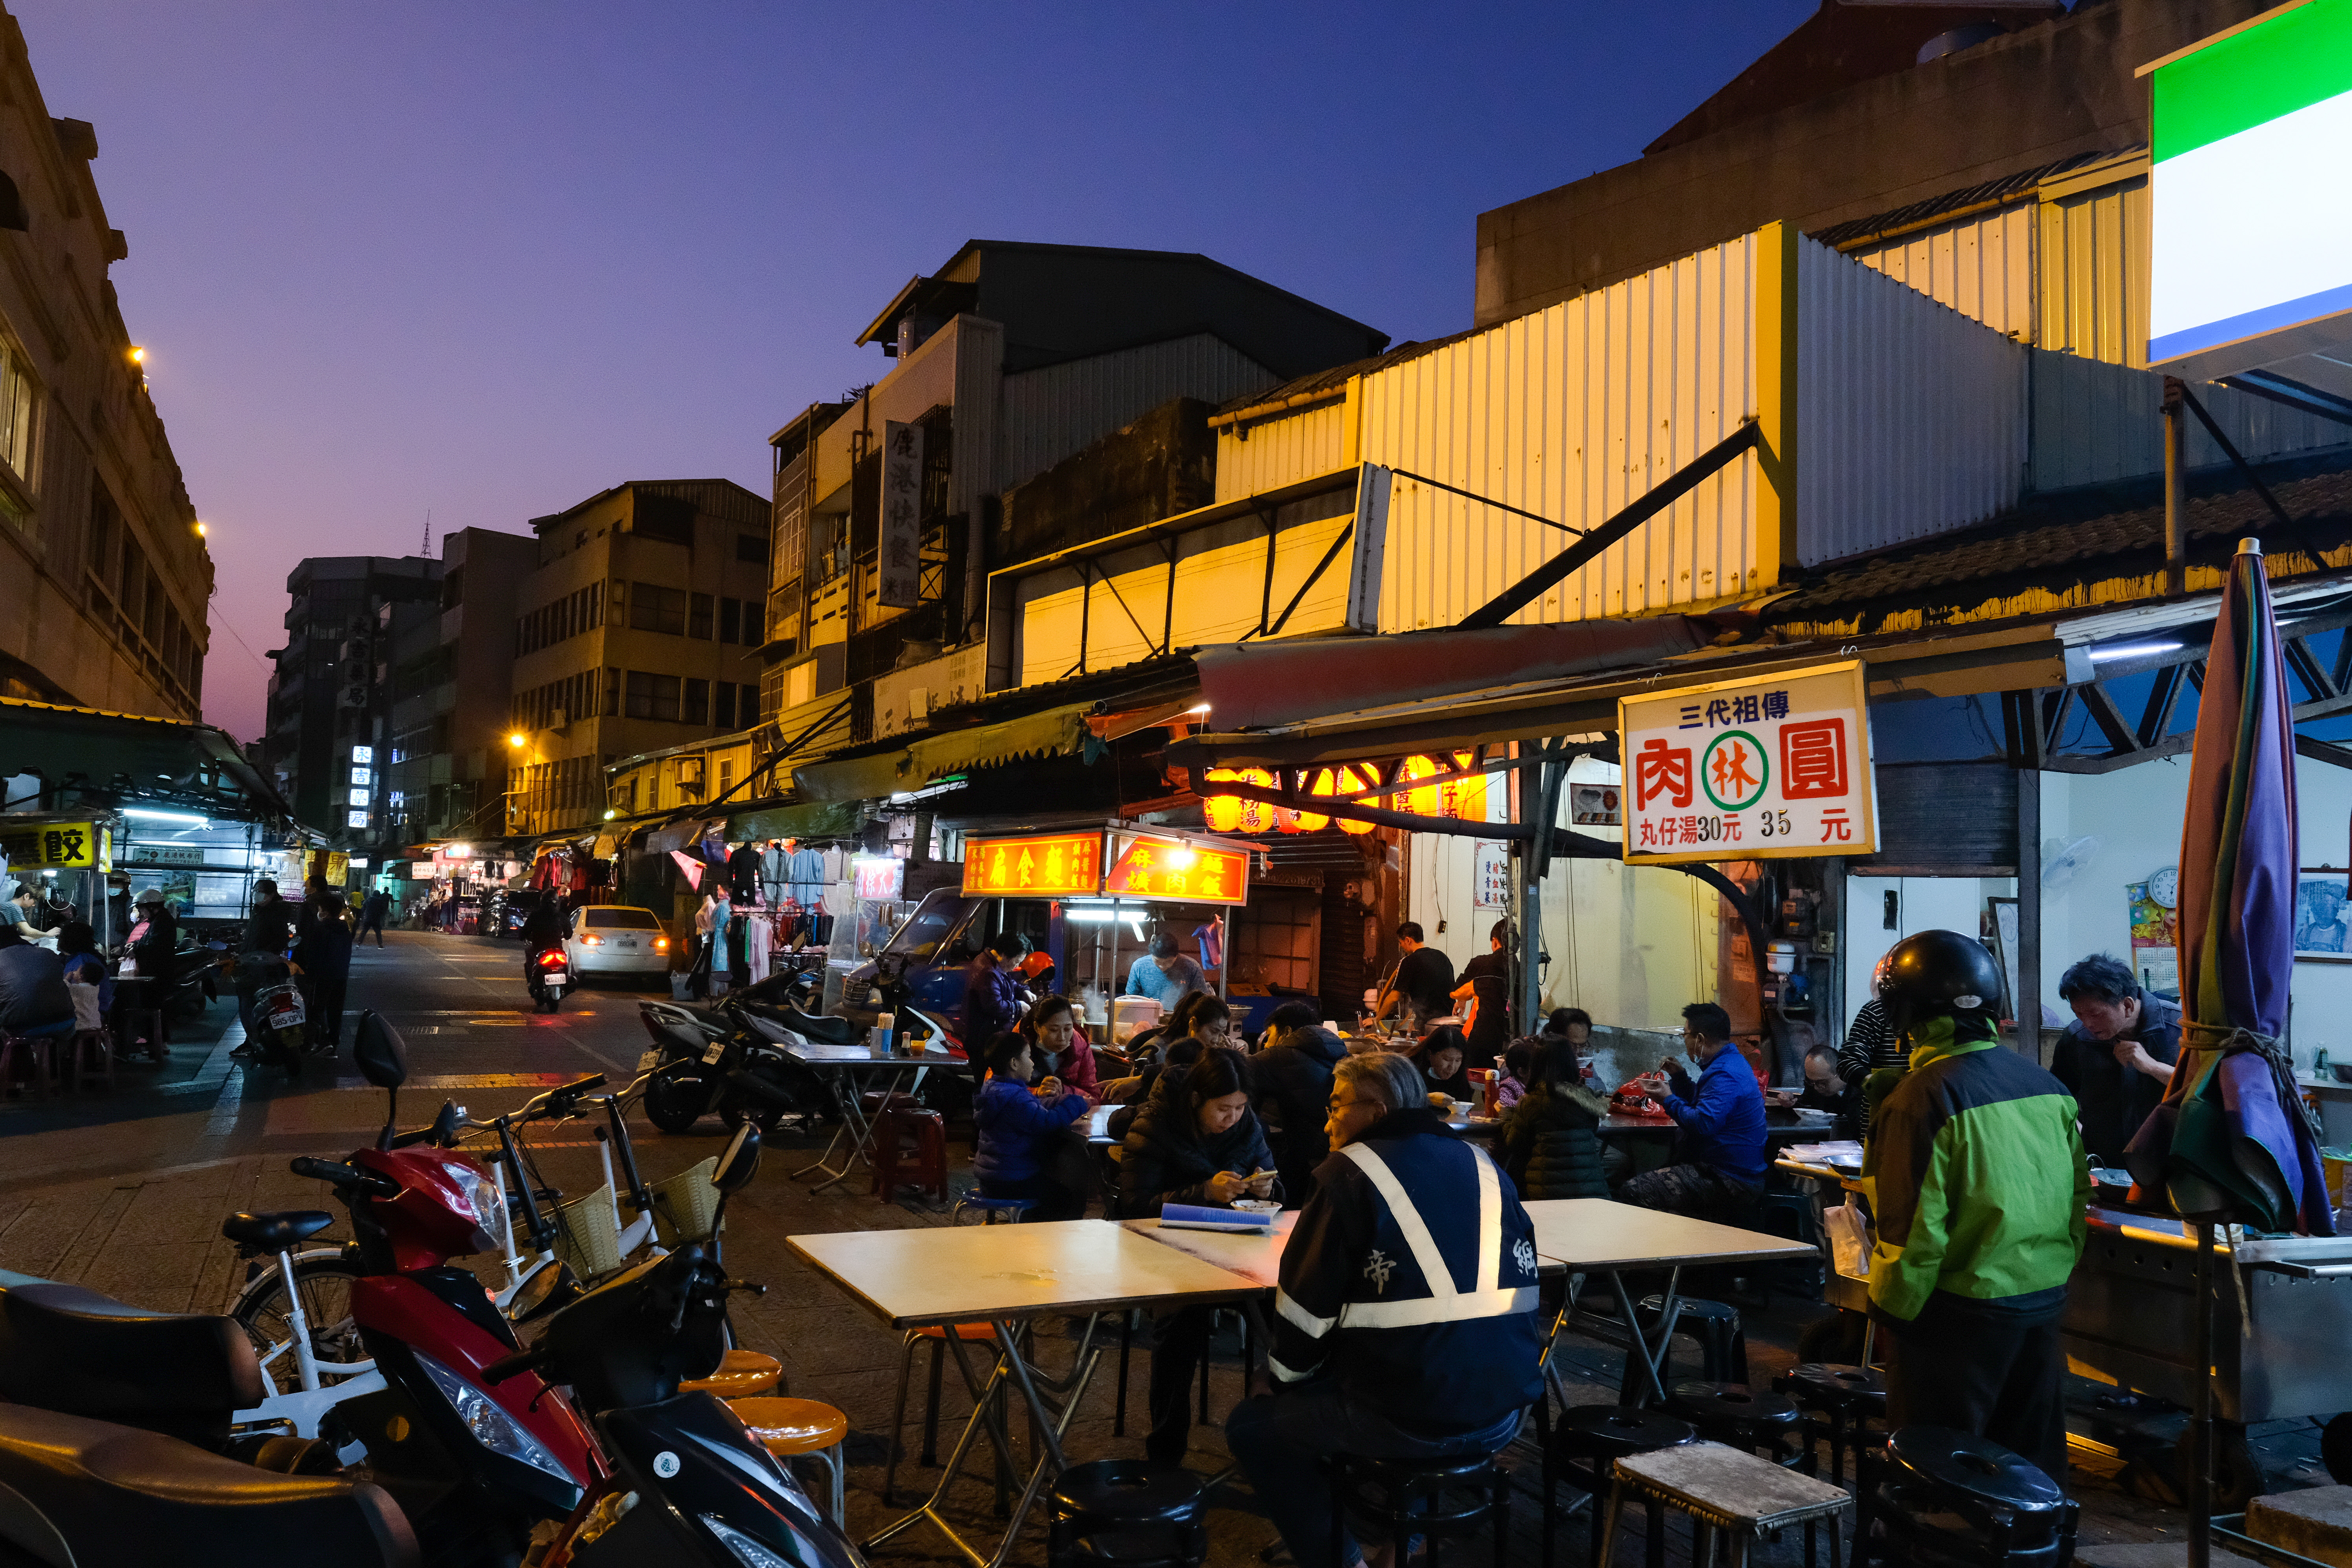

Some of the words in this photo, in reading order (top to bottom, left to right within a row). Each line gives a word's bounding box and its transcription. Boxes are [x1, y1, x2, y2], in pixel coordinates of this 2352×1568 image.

[1679, 691, 1789, 729] 三代祖傳
[1636, 739, 1693, 811] 肉
[1712, 740, 1760, 799] 林
[1779, 718, 1849, 800] 圓
[351, 748, 370, 826] 永吉藥局
[1640, 813, 1742, 846] 丸仔湯30元
[1761, 809, 1791, 837] 35
[1820, 808, 1851, 842] 元
[990, 845, 1064, 887] 扁食麵
[1080, 841, 1091, 888] 麻醬麵
[1125, 848, 1226, 874] 麻麵
[1364, 1250, 1397, 1295] 帝
